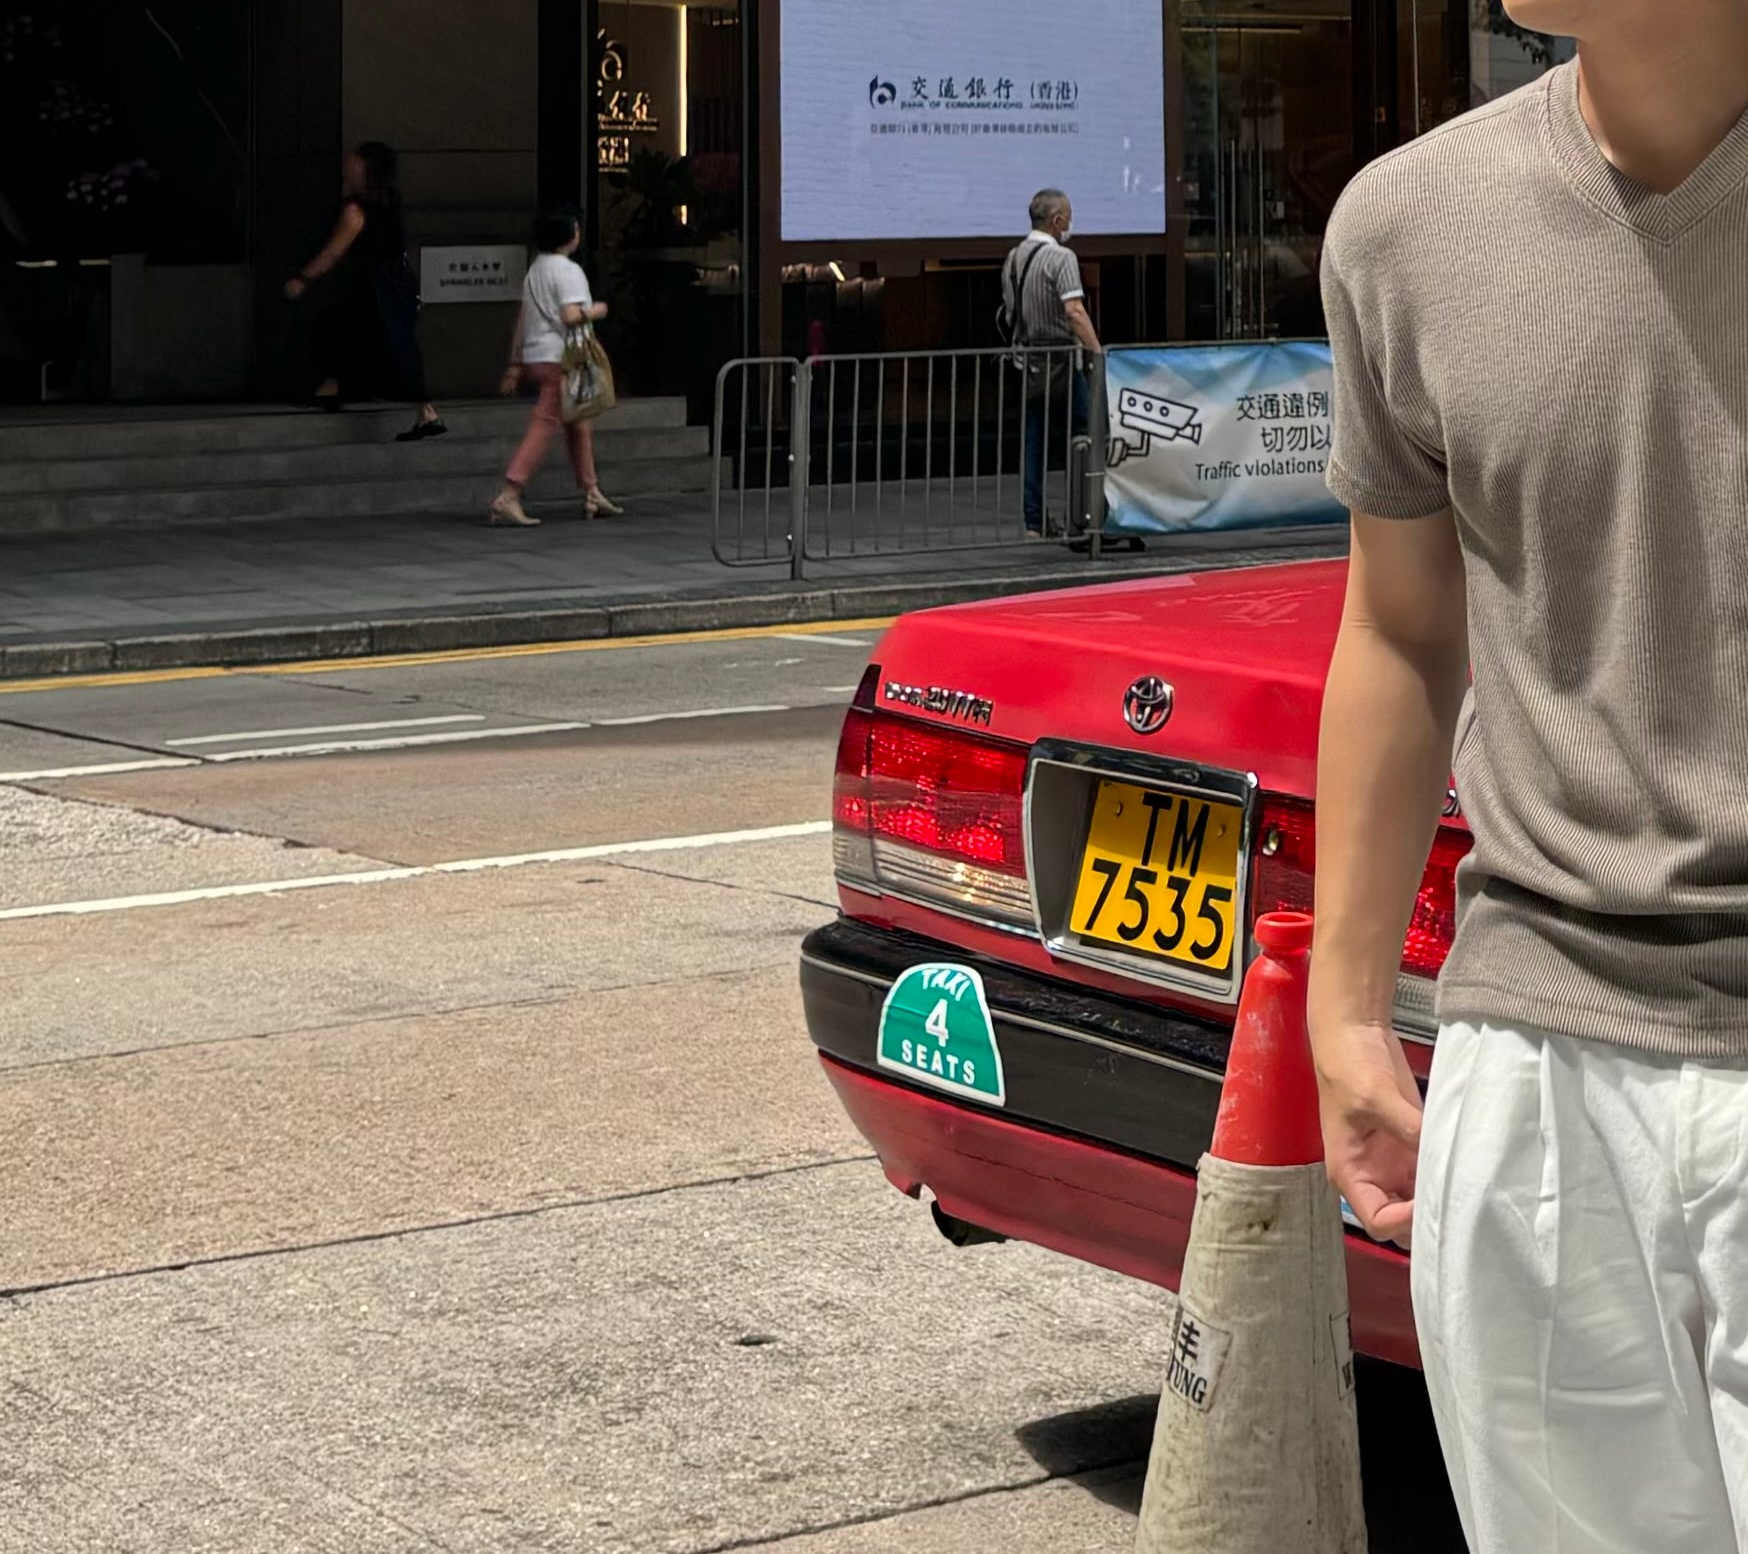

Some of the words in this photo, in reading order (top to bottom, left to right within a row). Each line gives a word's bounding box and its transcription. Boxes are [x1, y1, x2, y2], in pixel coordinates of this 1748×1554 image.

[911, 75, 1015, 100] 交通銀行
[1236, 390, 1329, 422] 交通違例
[1261, 423, 1332, 453] 切勿以
[1194, 459, 1242, 481] Traffic
[1244, 456, 1324, 477] violations
[1141, 791, 1210, 877] TM
[1084, 857, 1233, 961] 7535
[921, 968, 971, 1002] TAXI
[925, 998, 949, 1048] 4
[901, 1038, 976, 1086] SEATS
